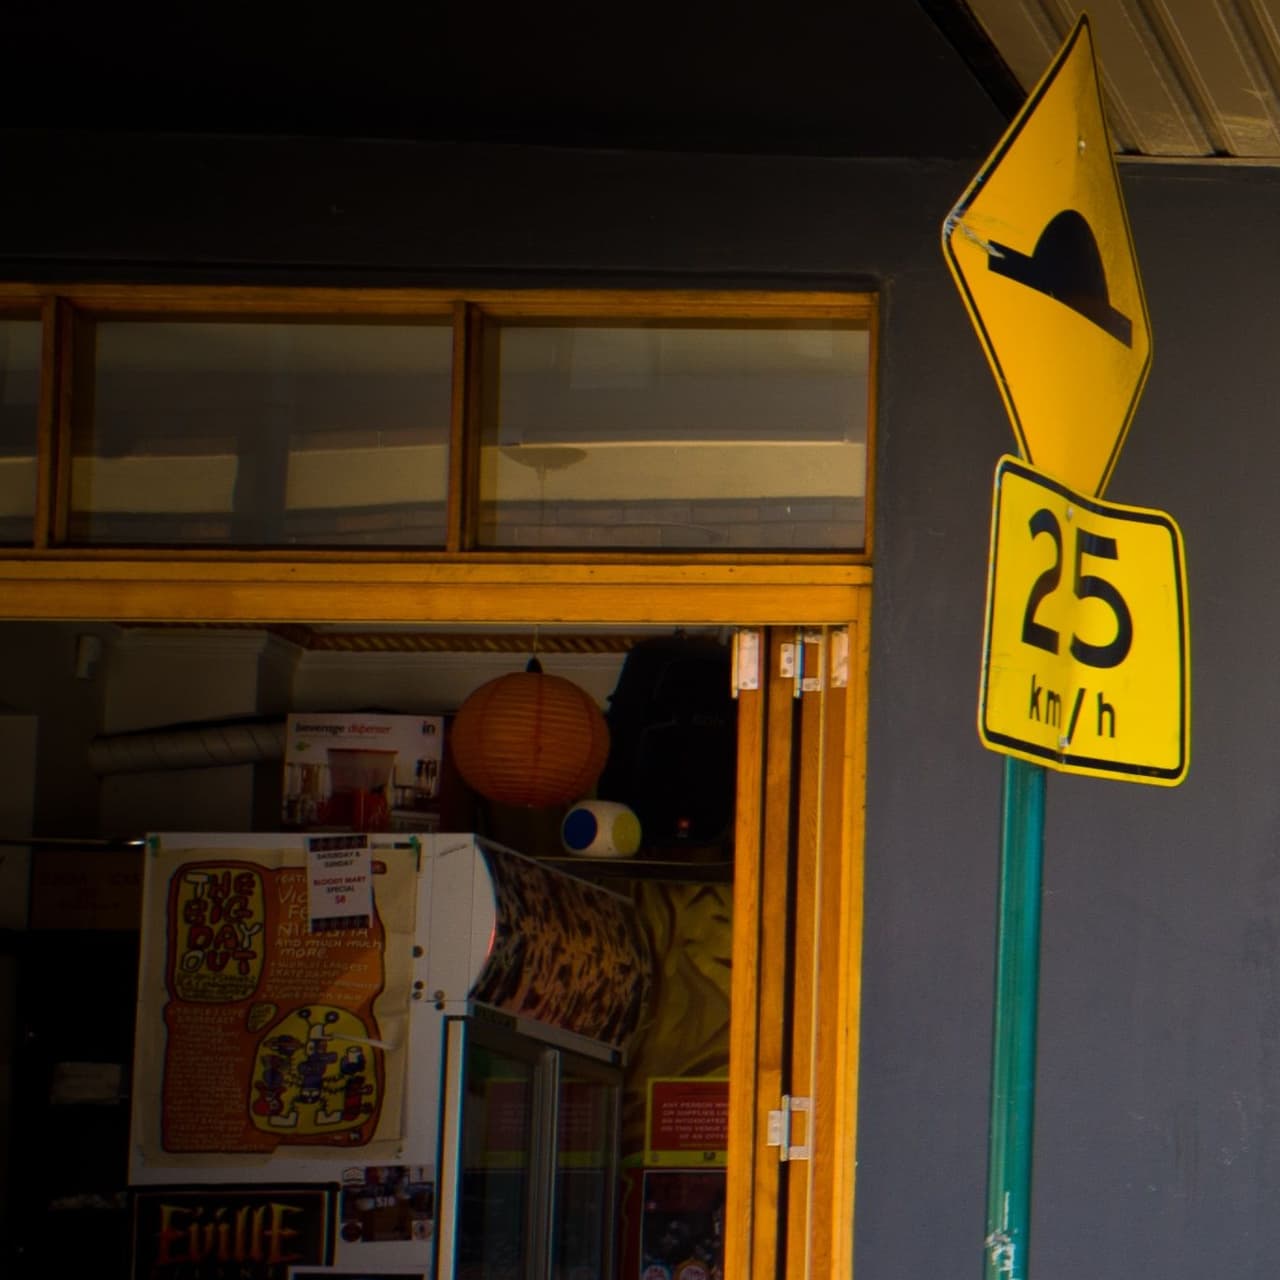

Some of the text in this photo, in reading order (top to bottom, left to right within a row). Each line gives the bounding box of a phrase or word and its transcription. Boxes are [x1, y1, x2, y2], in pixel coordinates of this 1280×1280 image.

[1021, 508, 1132, 668] 25
[1028, 674, 1116, 744] km/h
[185, 871, 256, 899] THE
[184, 897, 254, 926] BIG
[187, 922, 263, 950] DAY
[182, 950, 257, 975] OUT
